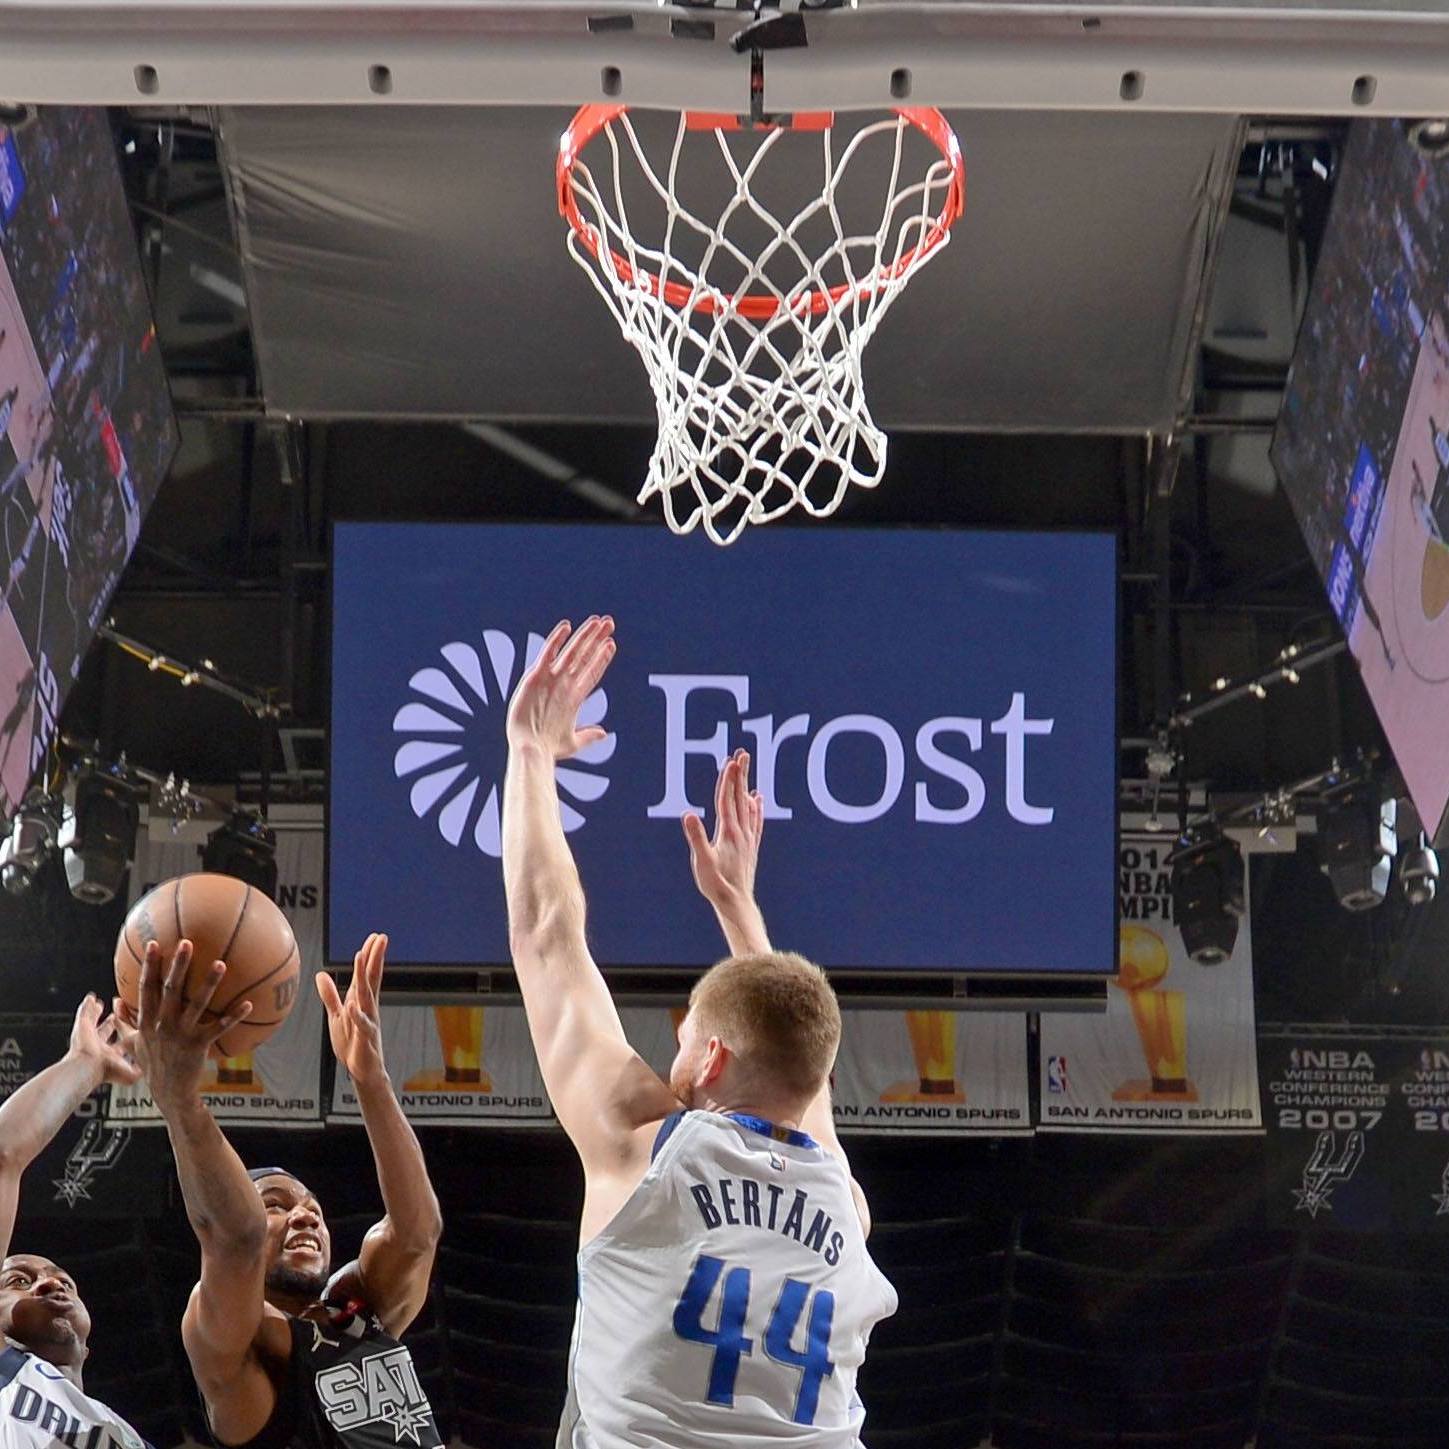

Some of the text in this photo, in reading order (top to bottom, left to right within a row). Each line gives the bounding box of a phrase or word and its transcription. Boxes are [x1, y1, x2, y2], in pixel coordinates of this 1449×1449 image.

[646, 674, 1055, 826] Frost
[1304, 1051, 1375, 1068] NBA
[1284, 1069, 1374, 1081] WESTERN
[1269, 1081, 1390, 1094] CONFERENCE
[251, 1097, 314, 1110] SPURS
[402, 1095, 543, 1109] NTONIO SPURS
[1274, 1094, 1386, 1107] CHAMPIONS
[833, 1105, 1021, 1120] AN ANTONIO SPURS
[1048, 1105, 1253, 1120] SAN ANTONIO SPURS
[1279, 1109, 1383, 1130] 2007
[673, 1254, 835, 1427] 44
[315, 1346, 427, 1432] SAT
